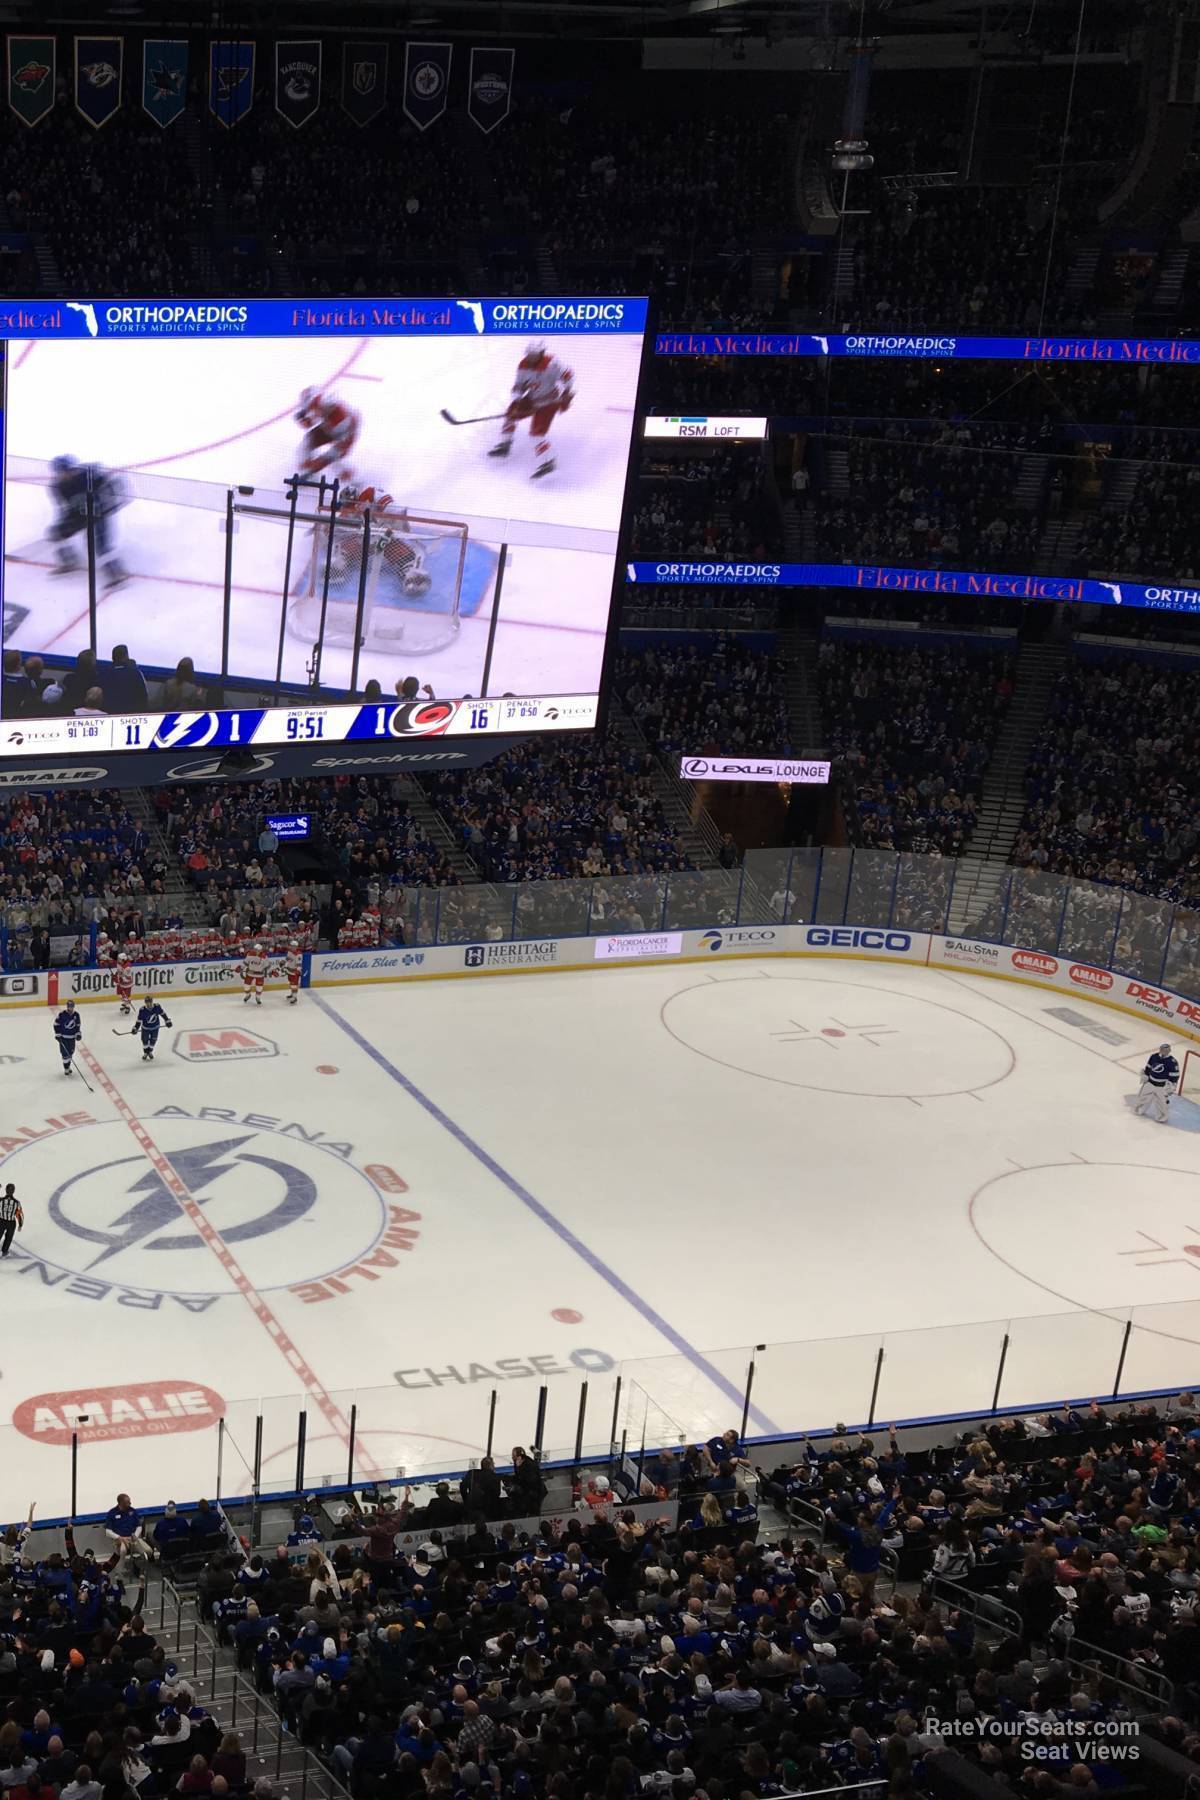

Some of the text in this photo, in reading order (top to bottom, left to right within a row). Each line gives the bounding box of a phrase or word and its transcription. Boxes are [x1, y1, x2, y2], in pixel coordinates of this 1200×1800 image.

[105, 306, 248, 324] ORTHOPAEDICS
[292, 307, 451, 327] Florida Medical
[492, 304, 624, 321] ORTHOPAEDICS
[107, 322, 246, 333] SPORTS MEDICINE SPINE
[493, 319, 622, 329] SPORTS MEDICINE SPINE
[713, 335, 800, 354] Medical
[845, 337, 956, 350] ORTHOPAEDICS
[1023, 339, 1113, 360] Florida
[678, 425, 741, 437] RSM LOFT
[656, 563, 781, 578] ORTHOPAEDICS
[856, 567, 1084, 601] Florida Medical
[1145, 588, 1200, 604] ORTH
[467, 701, 495, 710] SHOTS
[506, 699, 542, 708] PENALTY
[506, 706, 538, 719] 37 0:50
[66, 719, 105, 728] PENALTY
[119, 717, 149, 726] SHOTS
[228, 713, 241, 742] 1
[286, 716, 324, 740] 9:51
[374, 707, 386, 735] 1
[470, 709, 489, 730] 16
[68, 726, 99, 738] 91 1:03
[125, 725, 141, 745] 11
[311, 752, 464, 768] Spectrum
[712, 763, 826, 778] LEXUS LOUNGE
[725, 931, 776, 942] TECO
[805, 928, 912, 952] GEICO
[488, 942, 558, 957] HERITAGE
[321, 955, 398, 972] Florida Blue
[487, 953, 558, 965] INSURANCE
[1014, 953, 1057, 971] AMALIE
[71, 966, 174, 994] Jägereister
[184, 967, 235, 985] Times
[1071, 967, 1113, 985] AMALIE
[1125, 982, 1173, 1009] DEX
[1135, 998, 1175, 1019] imaging
[189, 1046, 270, 1058] MARATHON
[152, 1104, 355, 1160] ARENA
[392, 1353, 569, 1390] CHASE
[32, 1389, 215, 1433] AMALIE
[81, 1421, 174, 1440] MOTOR OIL
